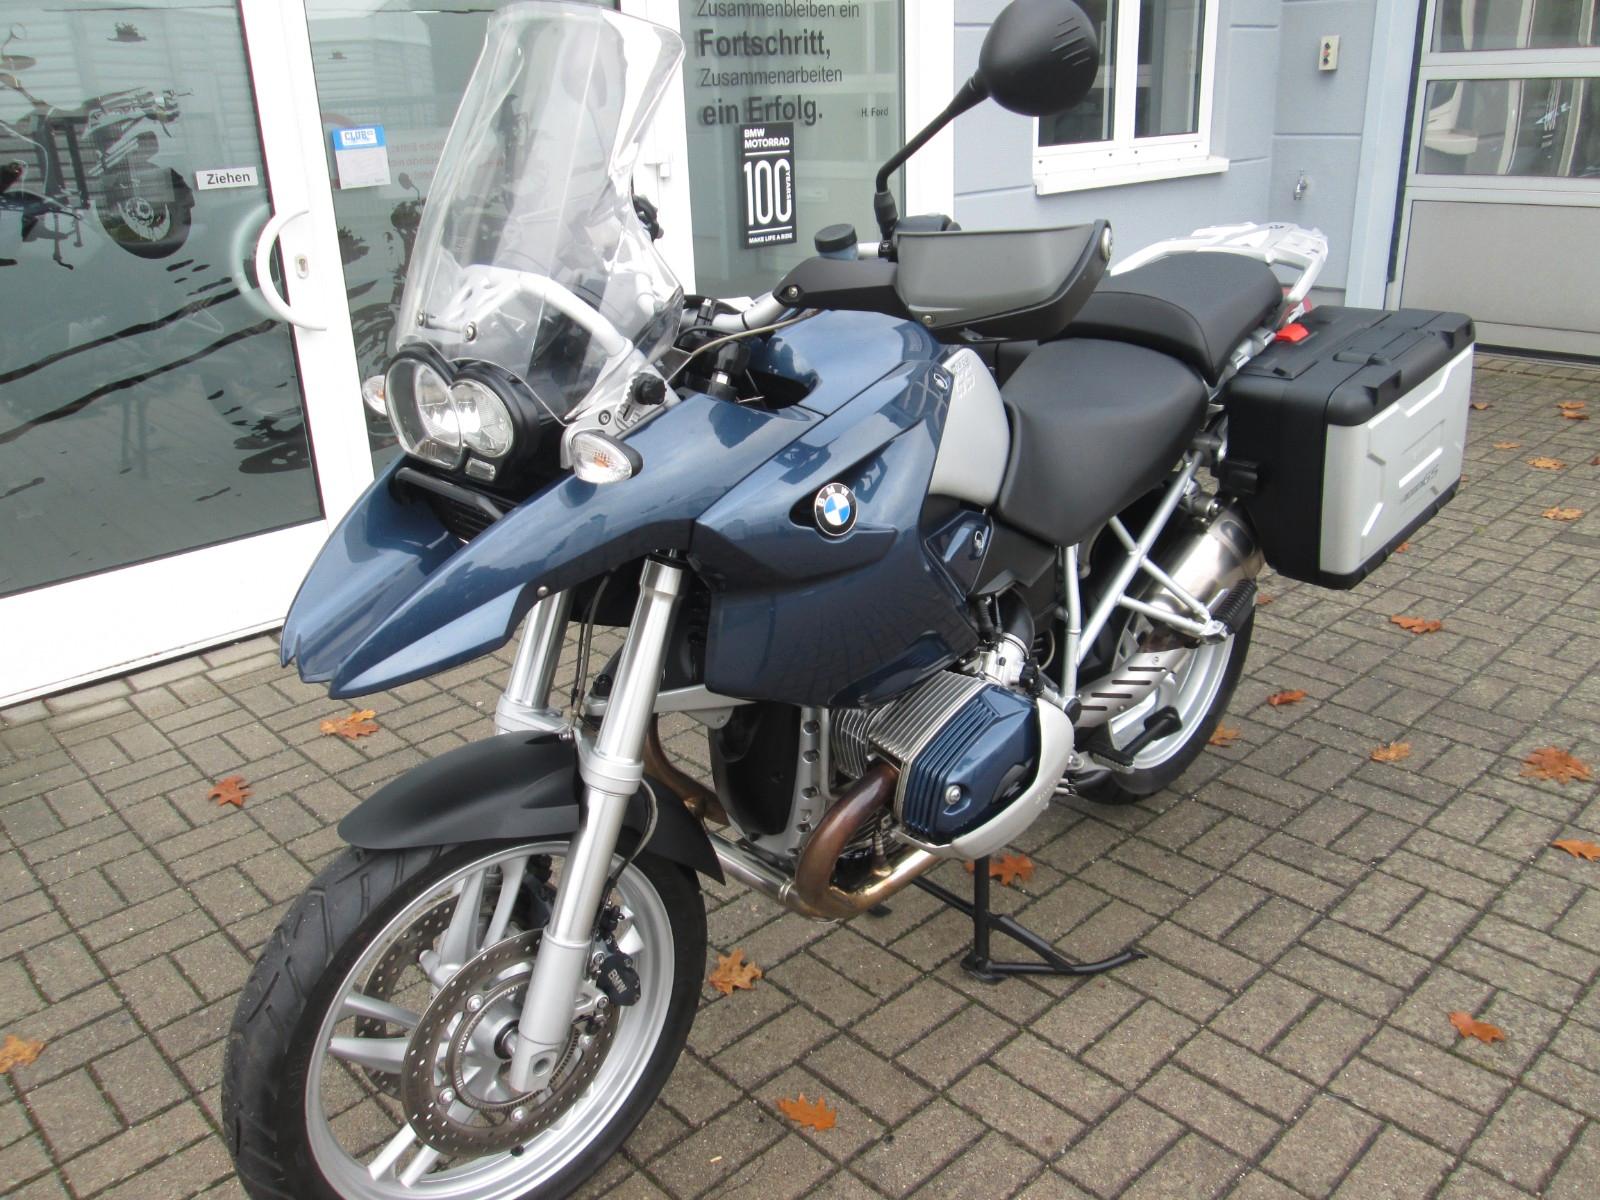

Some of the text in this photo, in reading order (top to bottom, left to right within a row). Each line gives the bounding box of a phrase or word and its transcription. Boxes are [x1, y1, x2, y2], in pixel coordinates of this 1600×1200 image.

[697, 0, 860, 18] Zusammenbleiben ein
[699, 28, 831, 59] Fortschritt,
[701, 66, 842, 87] Zusammenarbeiten
[702, 95, 823, 126] ein Erfolg.
[871, 107, 889, 117] Ford
[744, 128, 765, 138] BMW
[744, 137, 790, 149] MOTORRAD
[206, 172, 251, 185] Ziehen
[743, 158, 792, 226] 100
[748, 236, 765, 244] MAKE
[607, 968, 628, 994] BMW
